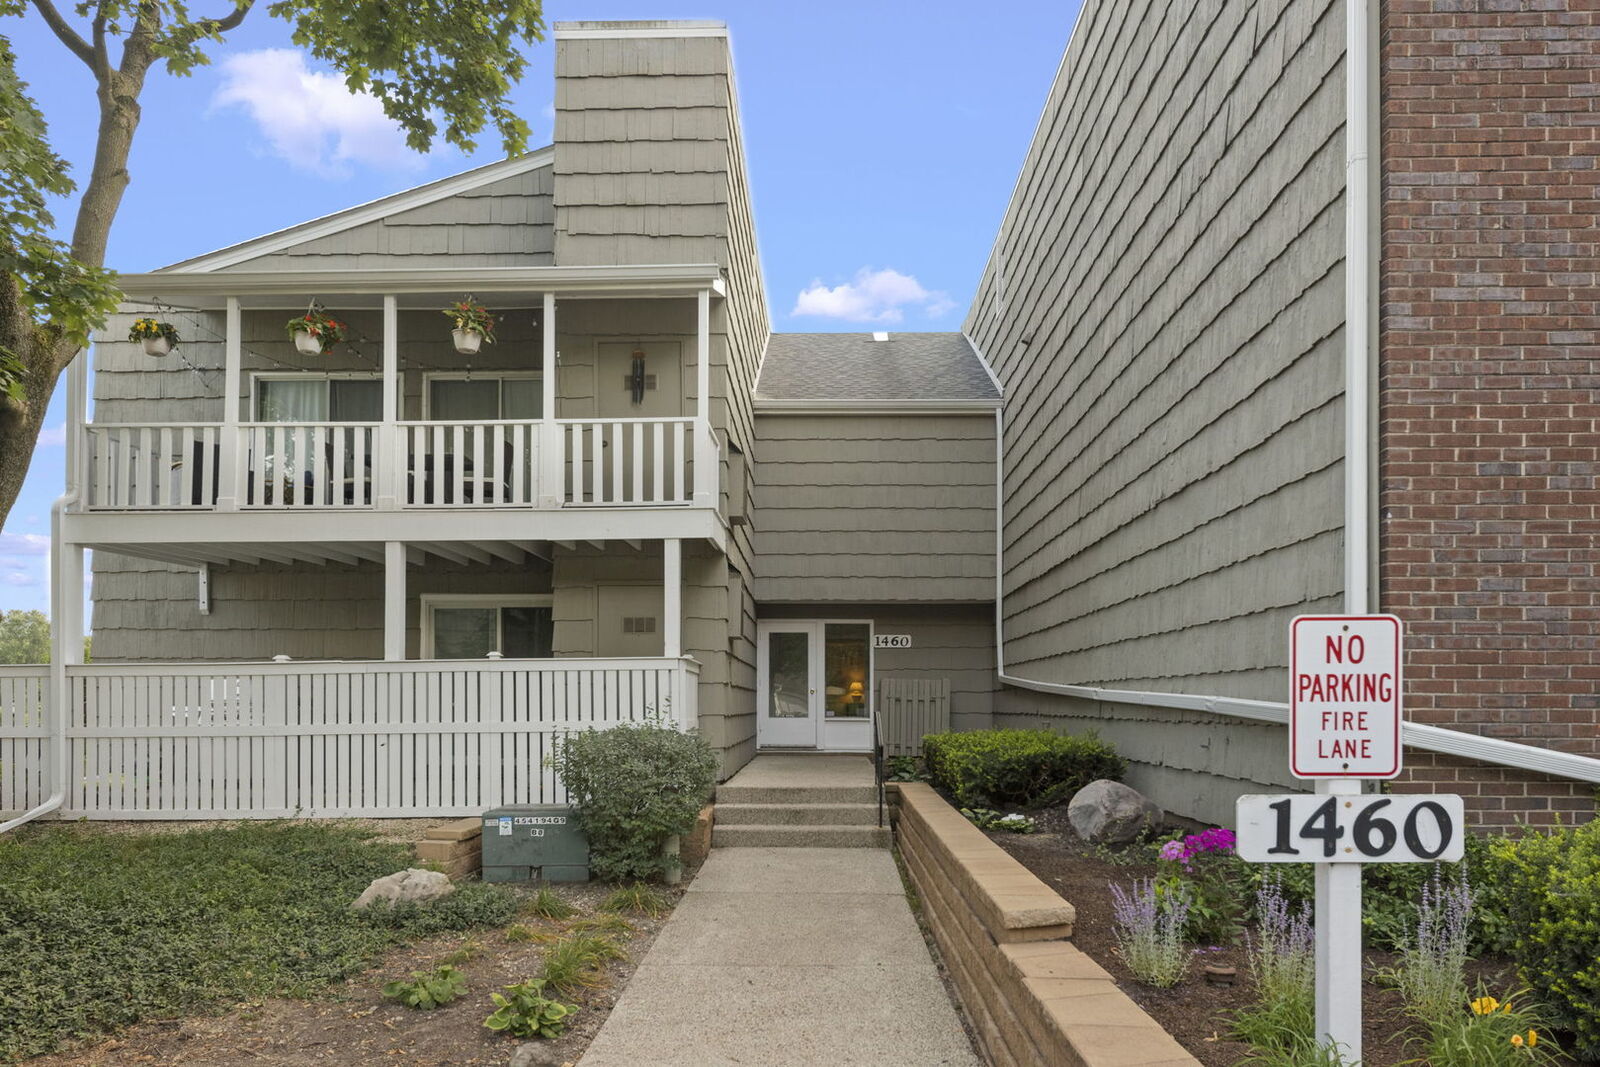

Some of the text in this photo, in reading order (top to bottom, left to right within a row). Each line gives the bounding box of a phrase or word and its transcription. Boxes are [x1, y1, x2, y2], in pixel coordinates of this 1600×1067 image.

[875, 635, 910, 647] 1460
[1325, 634, 1365, 664] NO
[1299, 673, 1392, 703] PARKING
[1322, 711, 1369, 731] FIRE
[1318, 739, 1372, 759] LANE
[1267, 796, 1453, 860] 1460
